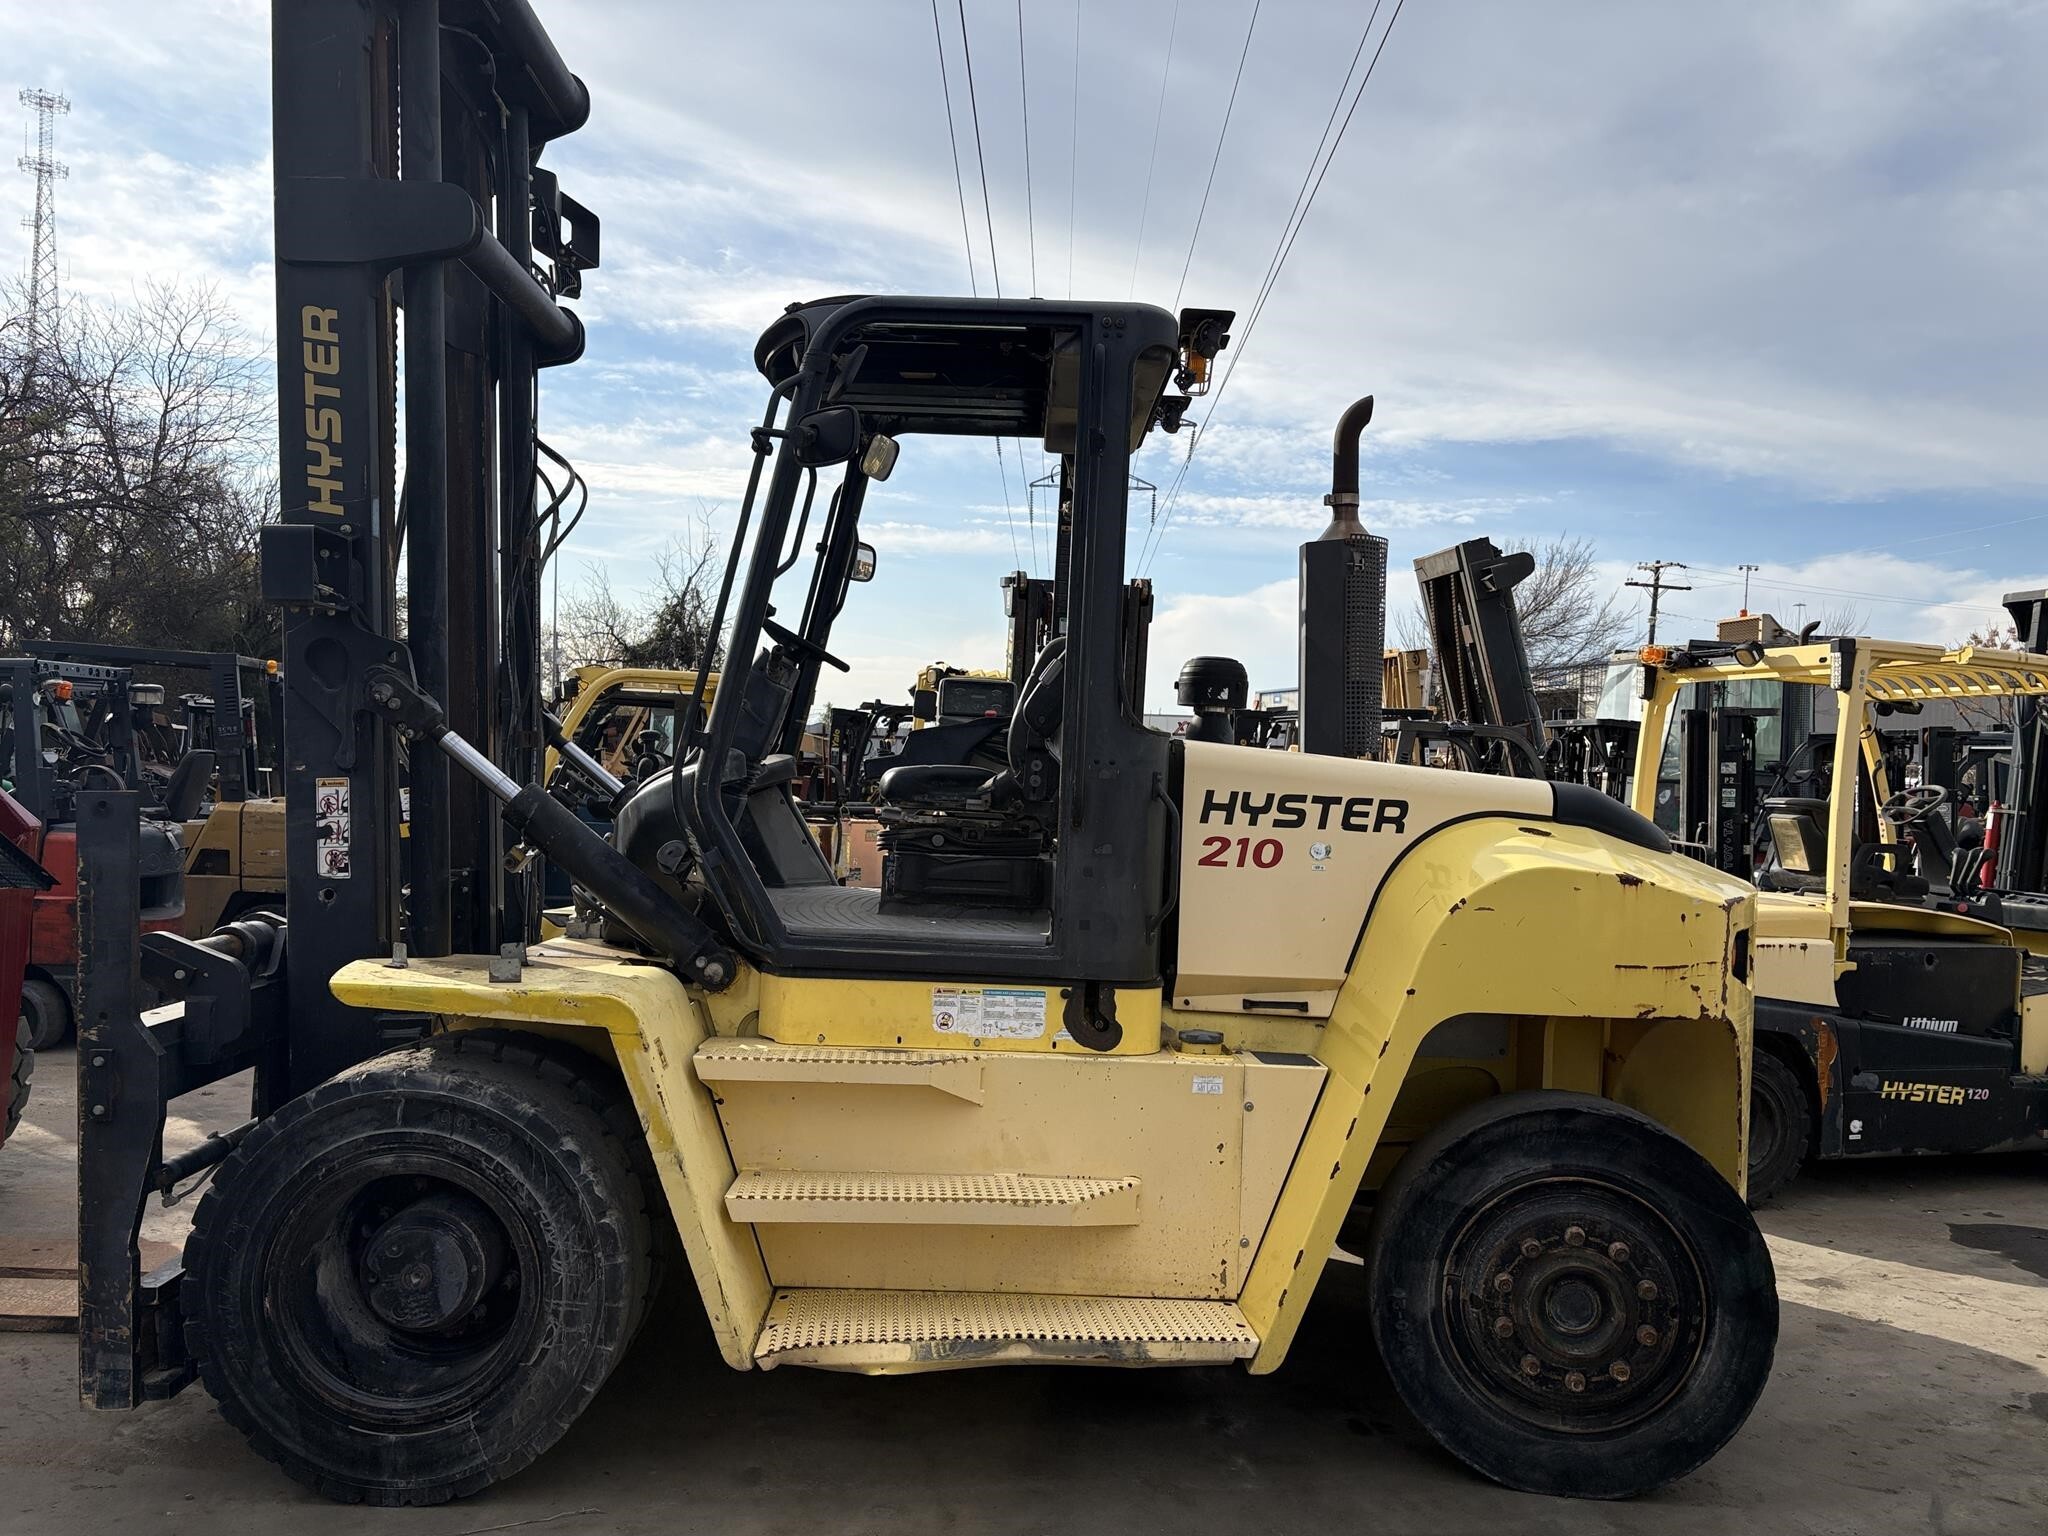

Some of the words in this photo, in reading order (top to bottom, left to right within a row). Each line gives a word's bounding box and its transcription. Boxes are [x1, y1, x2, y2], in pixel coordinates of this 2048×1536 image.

[302, 304, 345, 516] HYSTER
[1199, 789, 1409, 834] HYSTER
[1197, 836, 1284, 869] 210
[1902, 1016, 1959, 1033] Lithium
[1881, 1080, 1965, 1105] HYSTER
[1967, 1088, 1990, 1100] 120
